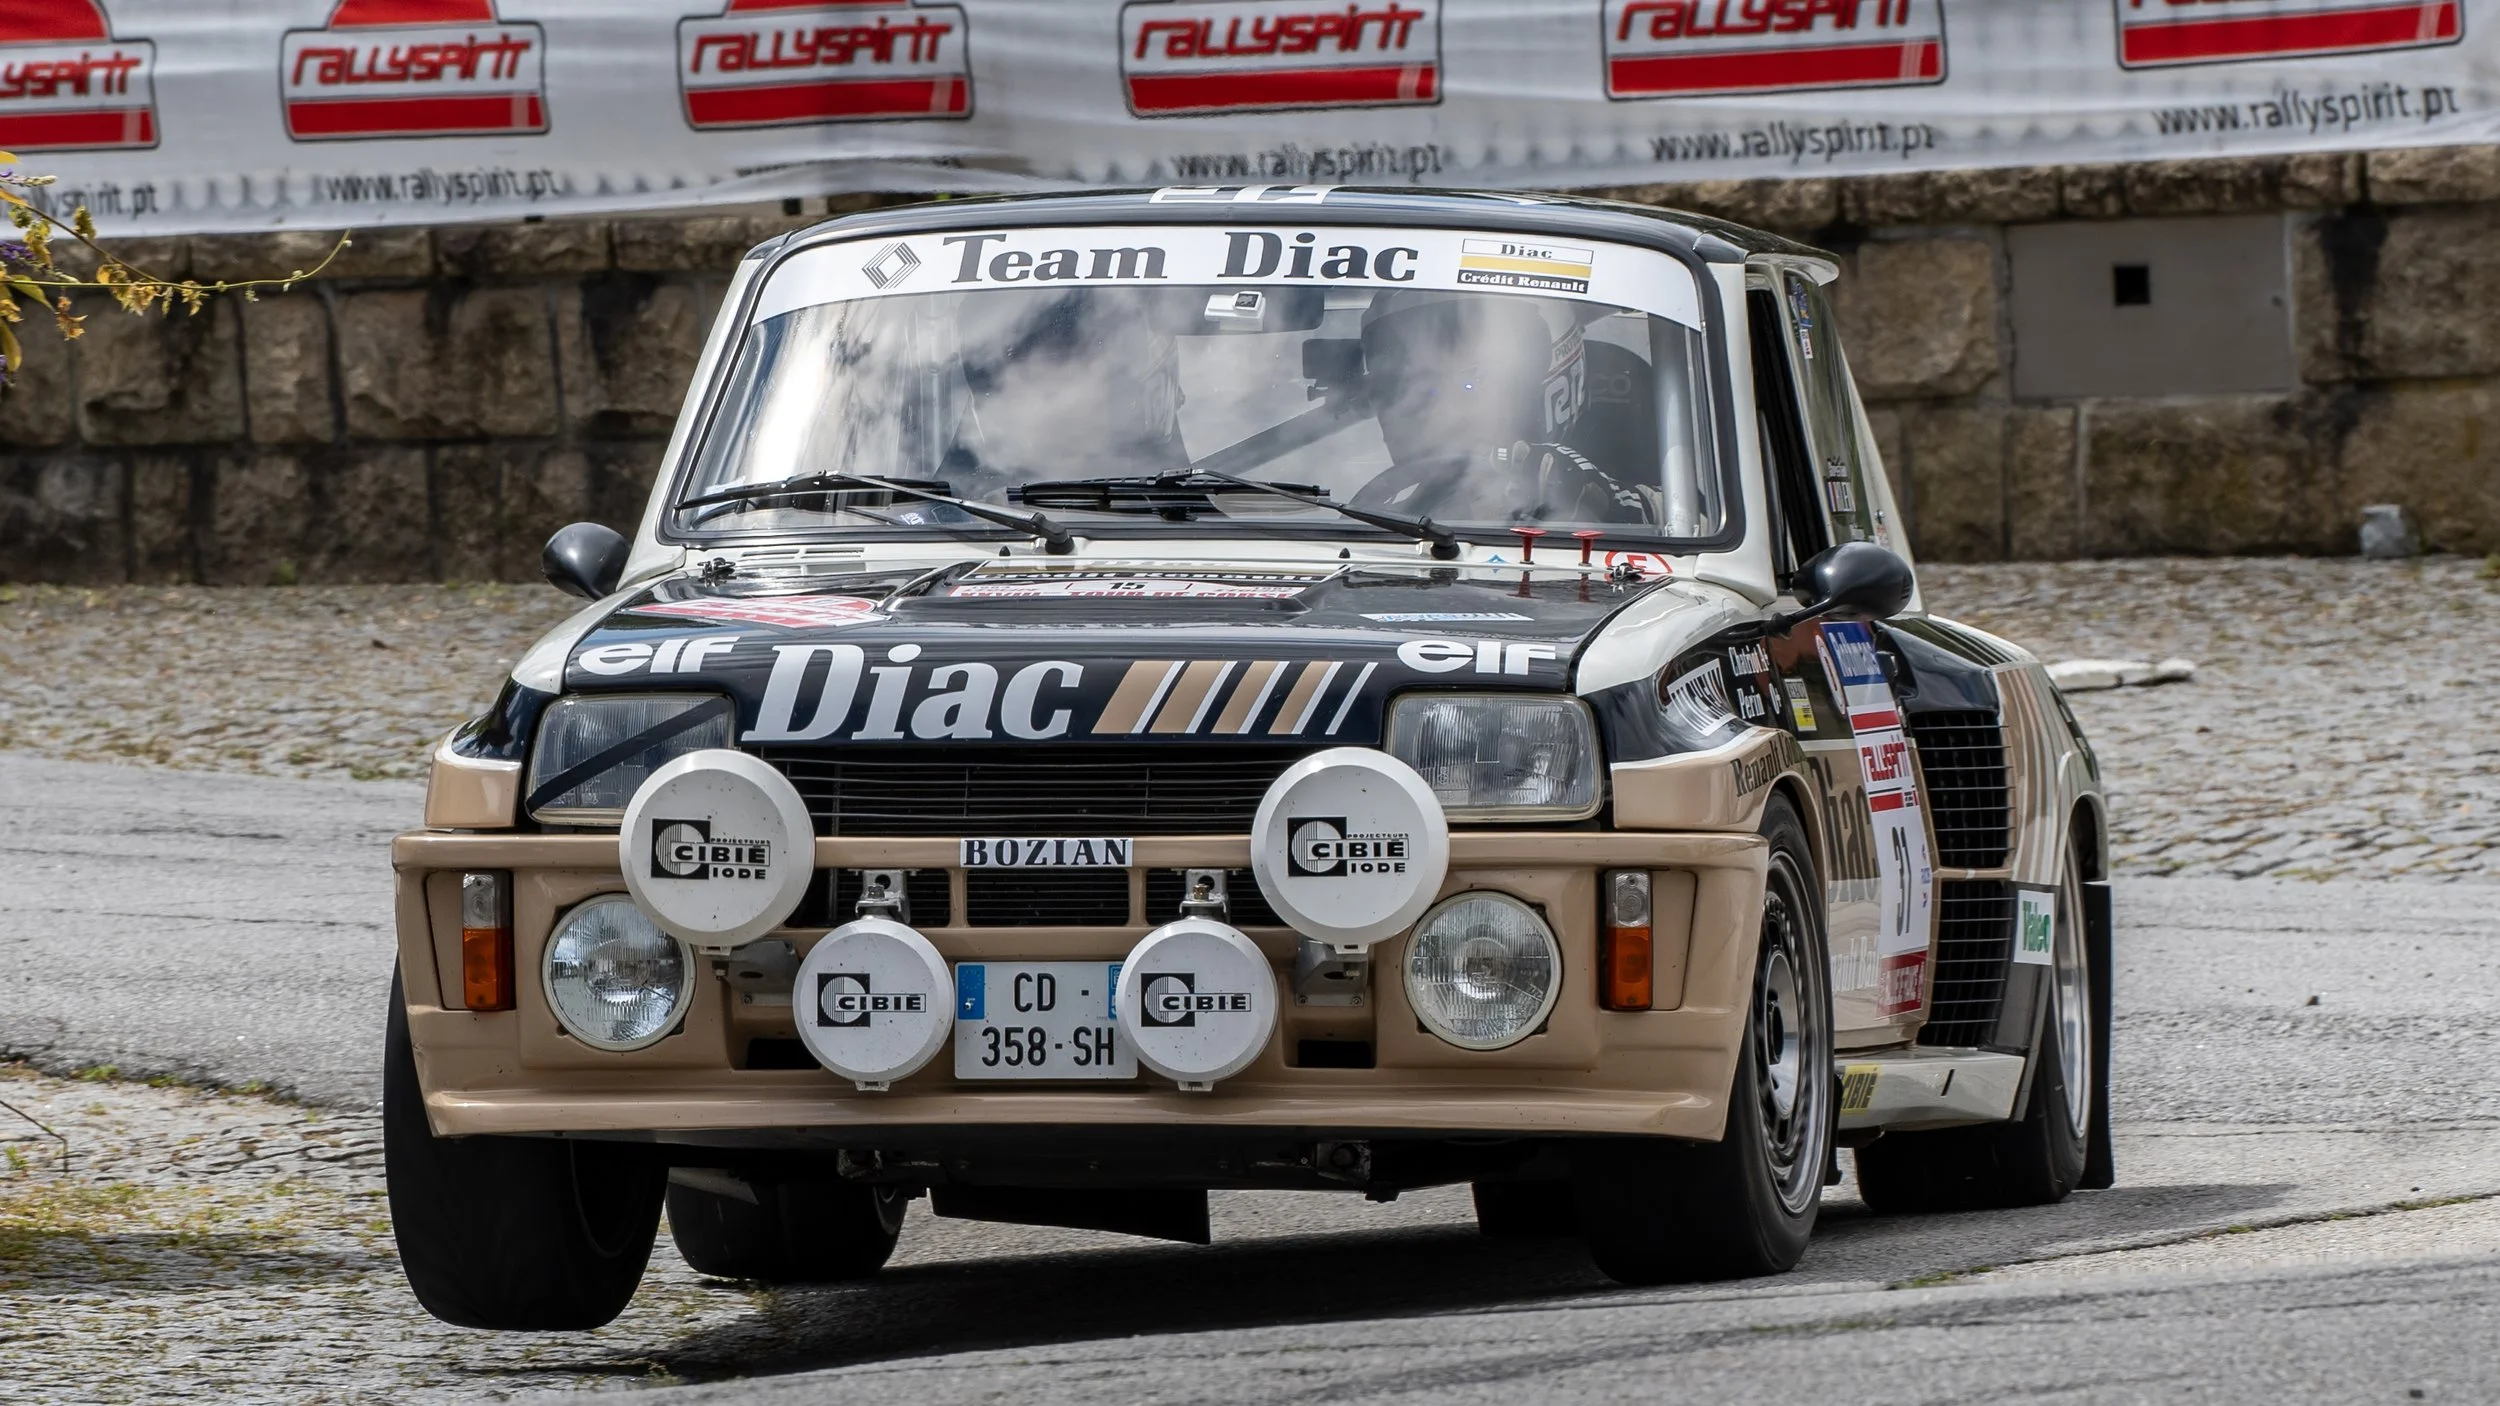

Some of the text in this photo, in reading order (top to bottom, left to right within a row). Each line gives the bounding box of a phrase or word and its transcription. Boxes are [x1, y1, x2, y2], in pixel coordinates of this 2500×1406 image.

[691, 17, 952, 74] rallyspirit
[1135, 3, 1425, 59] rallyspirit
[292, 35, 531, 86] rallyspirit
[2152, 82, 2460, 135] www.rallyspirit.pt
[1648, 119, 1934, 164] www.rallyspirit.pt
[1171, 142, 1443, 184] www.rallyspirit.pt
[328, 167, 563, 201] www.rallyspirit.pt
[943, 232, 1418, 283] Team Diac
[1500, 243, 1553, 259] Diac
[1461, 272, 1586, 292] Crédit Renault
[1108, 582, 1149, 590] 15
[579, 636, 741, 675] elf
[1397, 640, 1556, 675] elf
[741, 643, 1084, 742] Diac
[1731, 740, 1781, 797] Renault
[710, 837, 771, 845] PROJECTEURS
[963, 839, 1128, 866] BOZIAN
[713, 867, 766, 880] IODE
[1351, 863, 1406, 874] IODE
[1013, 972, 1057, 1013] CD
